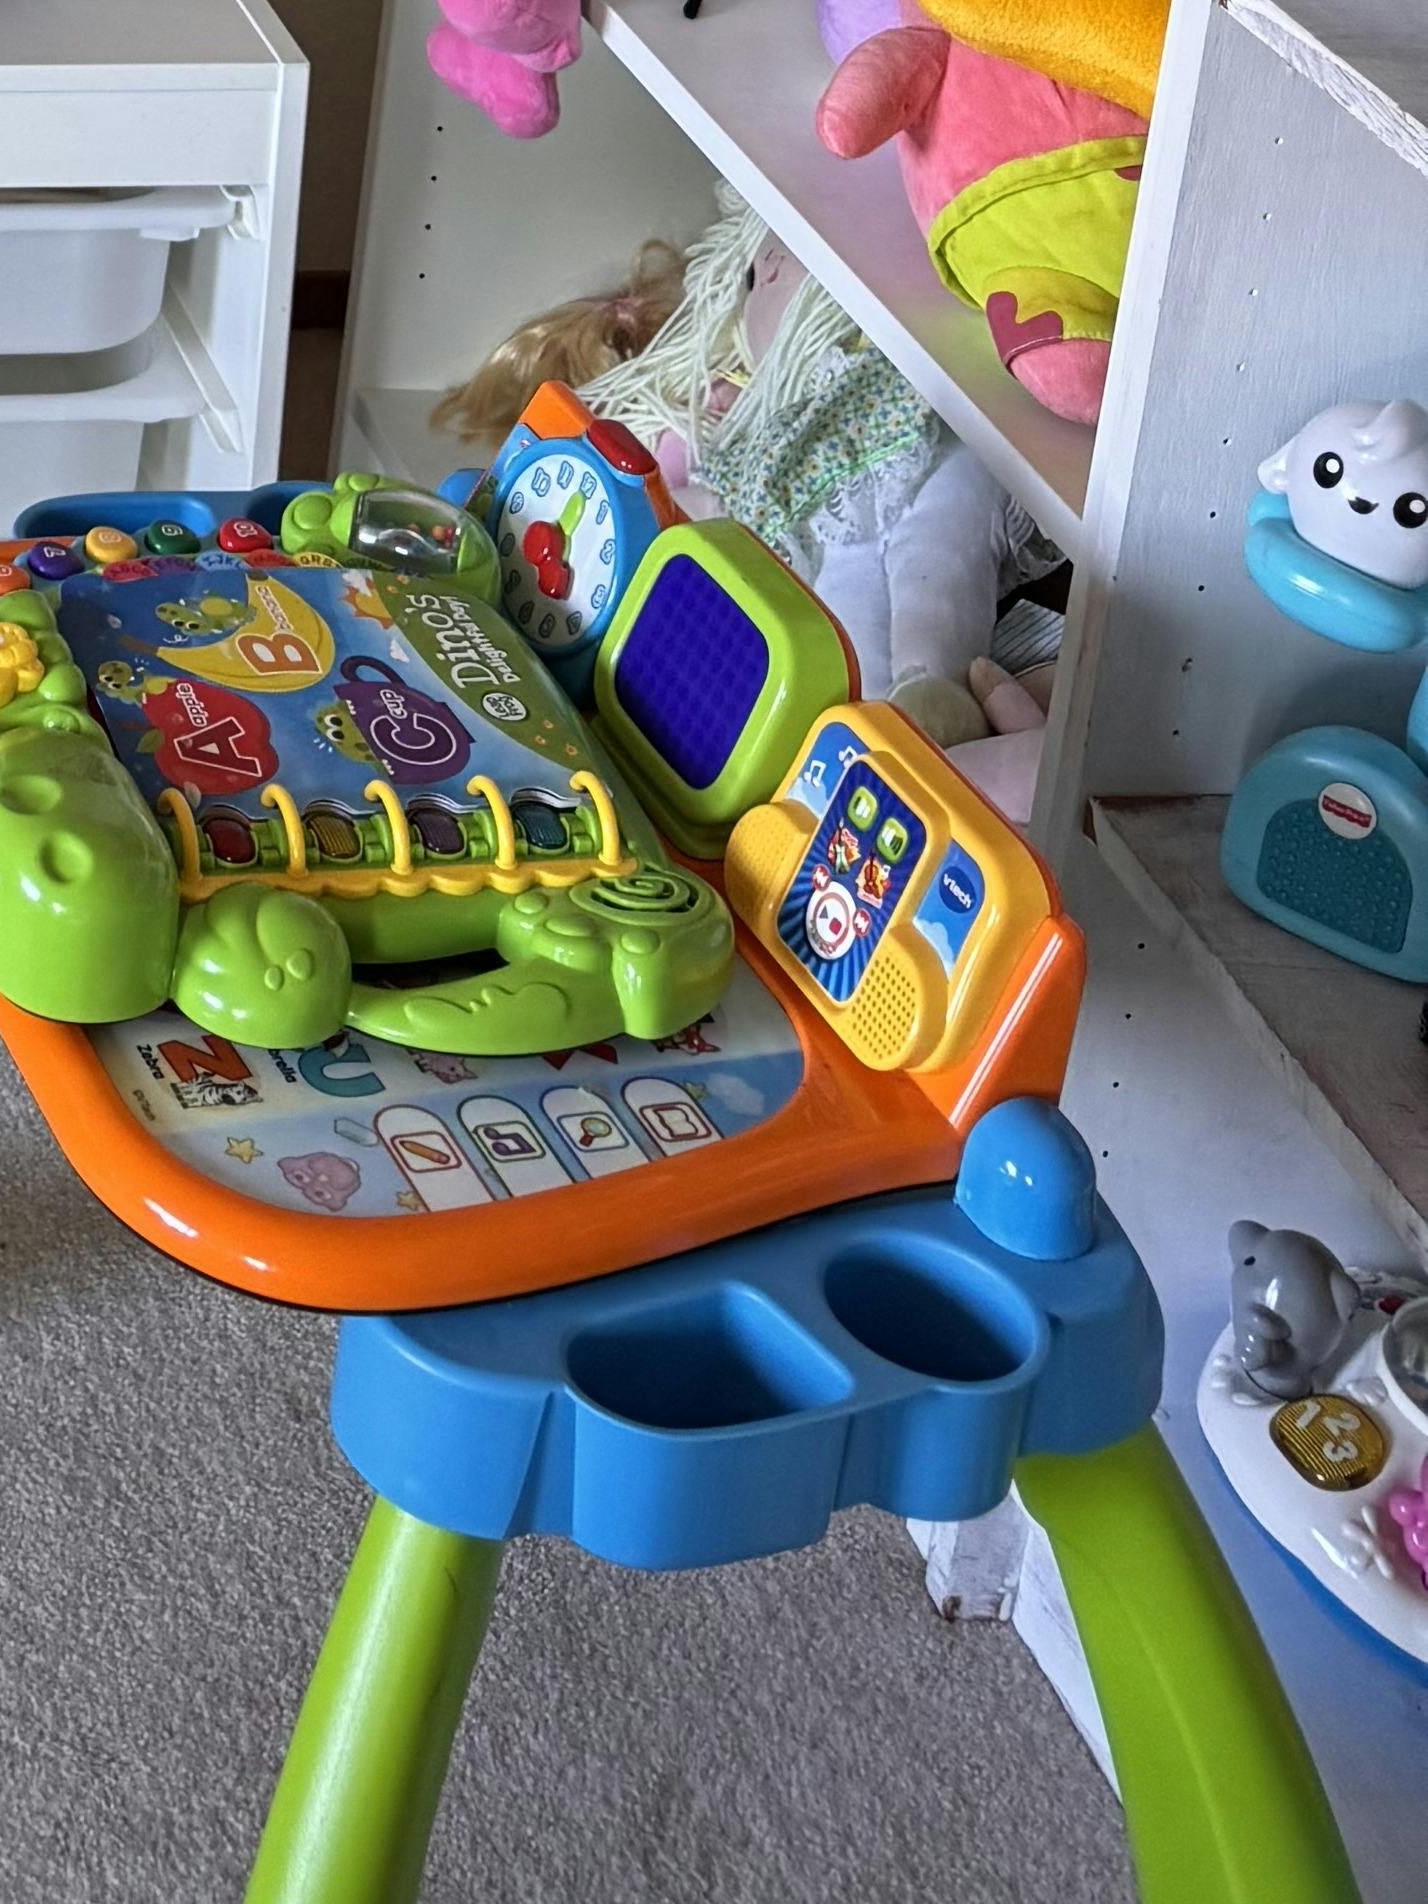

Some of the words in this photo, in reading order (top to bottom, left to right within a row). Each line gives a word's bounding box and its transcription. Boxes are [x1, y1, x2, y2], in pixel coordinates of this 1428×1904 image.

[236, 633, 322, 675] B
[406, 594, 499, 688] Dino's
[177, 683, 209, 727] apple
[380, 689, 407, 719] cup
[174, 717, 261, 777] A
[370, 712, 457, 765] C
[942, 873, 972, 910] vtech
[136, 1044, 164, 1080] Zebra
[1296, 1399, 1321, 1429] 1
[1322, 1412, 1360, 1437] 2
[1322, 1440, 1359, 1463] 3
